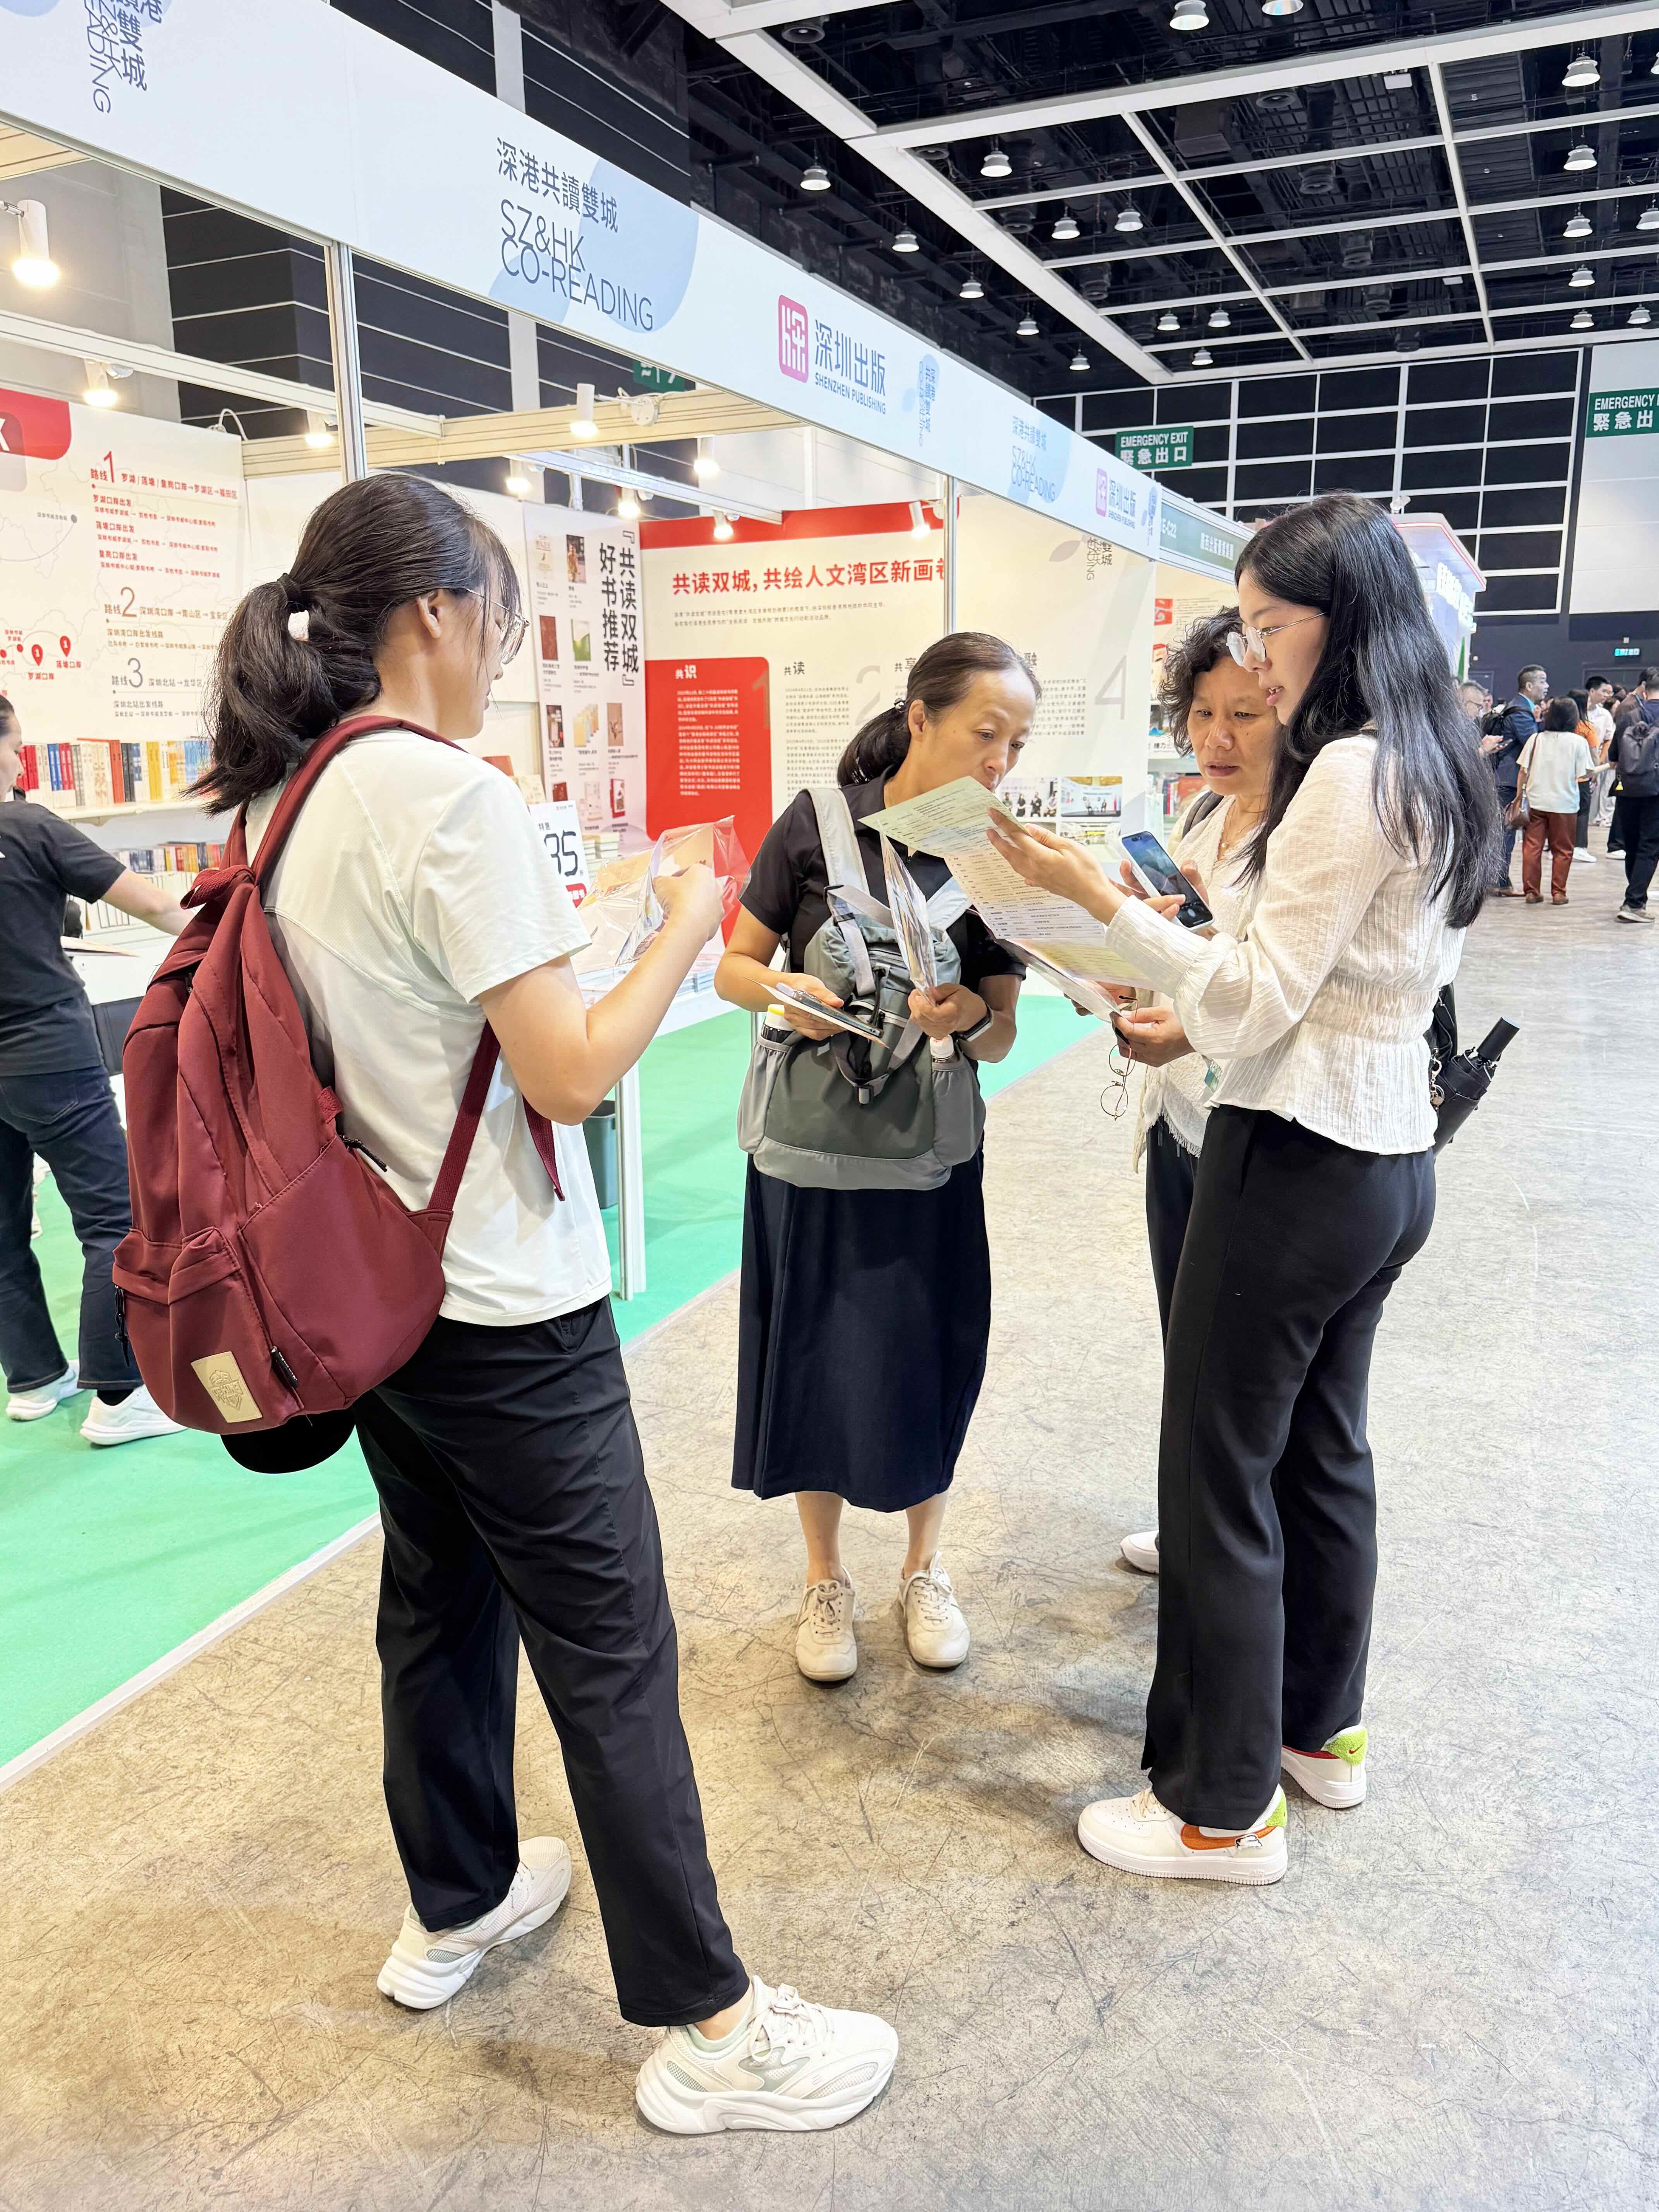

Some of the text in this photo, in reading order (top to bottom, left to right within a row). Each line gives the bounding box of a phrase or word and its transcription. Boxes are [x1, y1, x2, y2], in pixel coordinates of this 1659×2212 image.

[497, 137, 618, 233] 深港共讀雙城
[501, 199, 586, 271] SZ&HK
[501, 237, 653, 331] CO-READING
[814, 319, 886, 396] 深圳出版
[815, 372, 886, 415] SHENZHEN PUBLISHING
[1594, 394, 1656, 410] EMERGENCY
[1120, 431, 1188, 448] EMERGENCY EXIT
[1593, 409, 1653, 432] 緊急出
[1120, 446, 1187, 465] 緊急出口
[599, 542, 620, 672] 好书推荐
[675, 664, 697, 679] 共识
[783, 661, 805, 675] 共读
[1094, 654, 1127, 720] 4
[543, 830, 578, 877] 35
